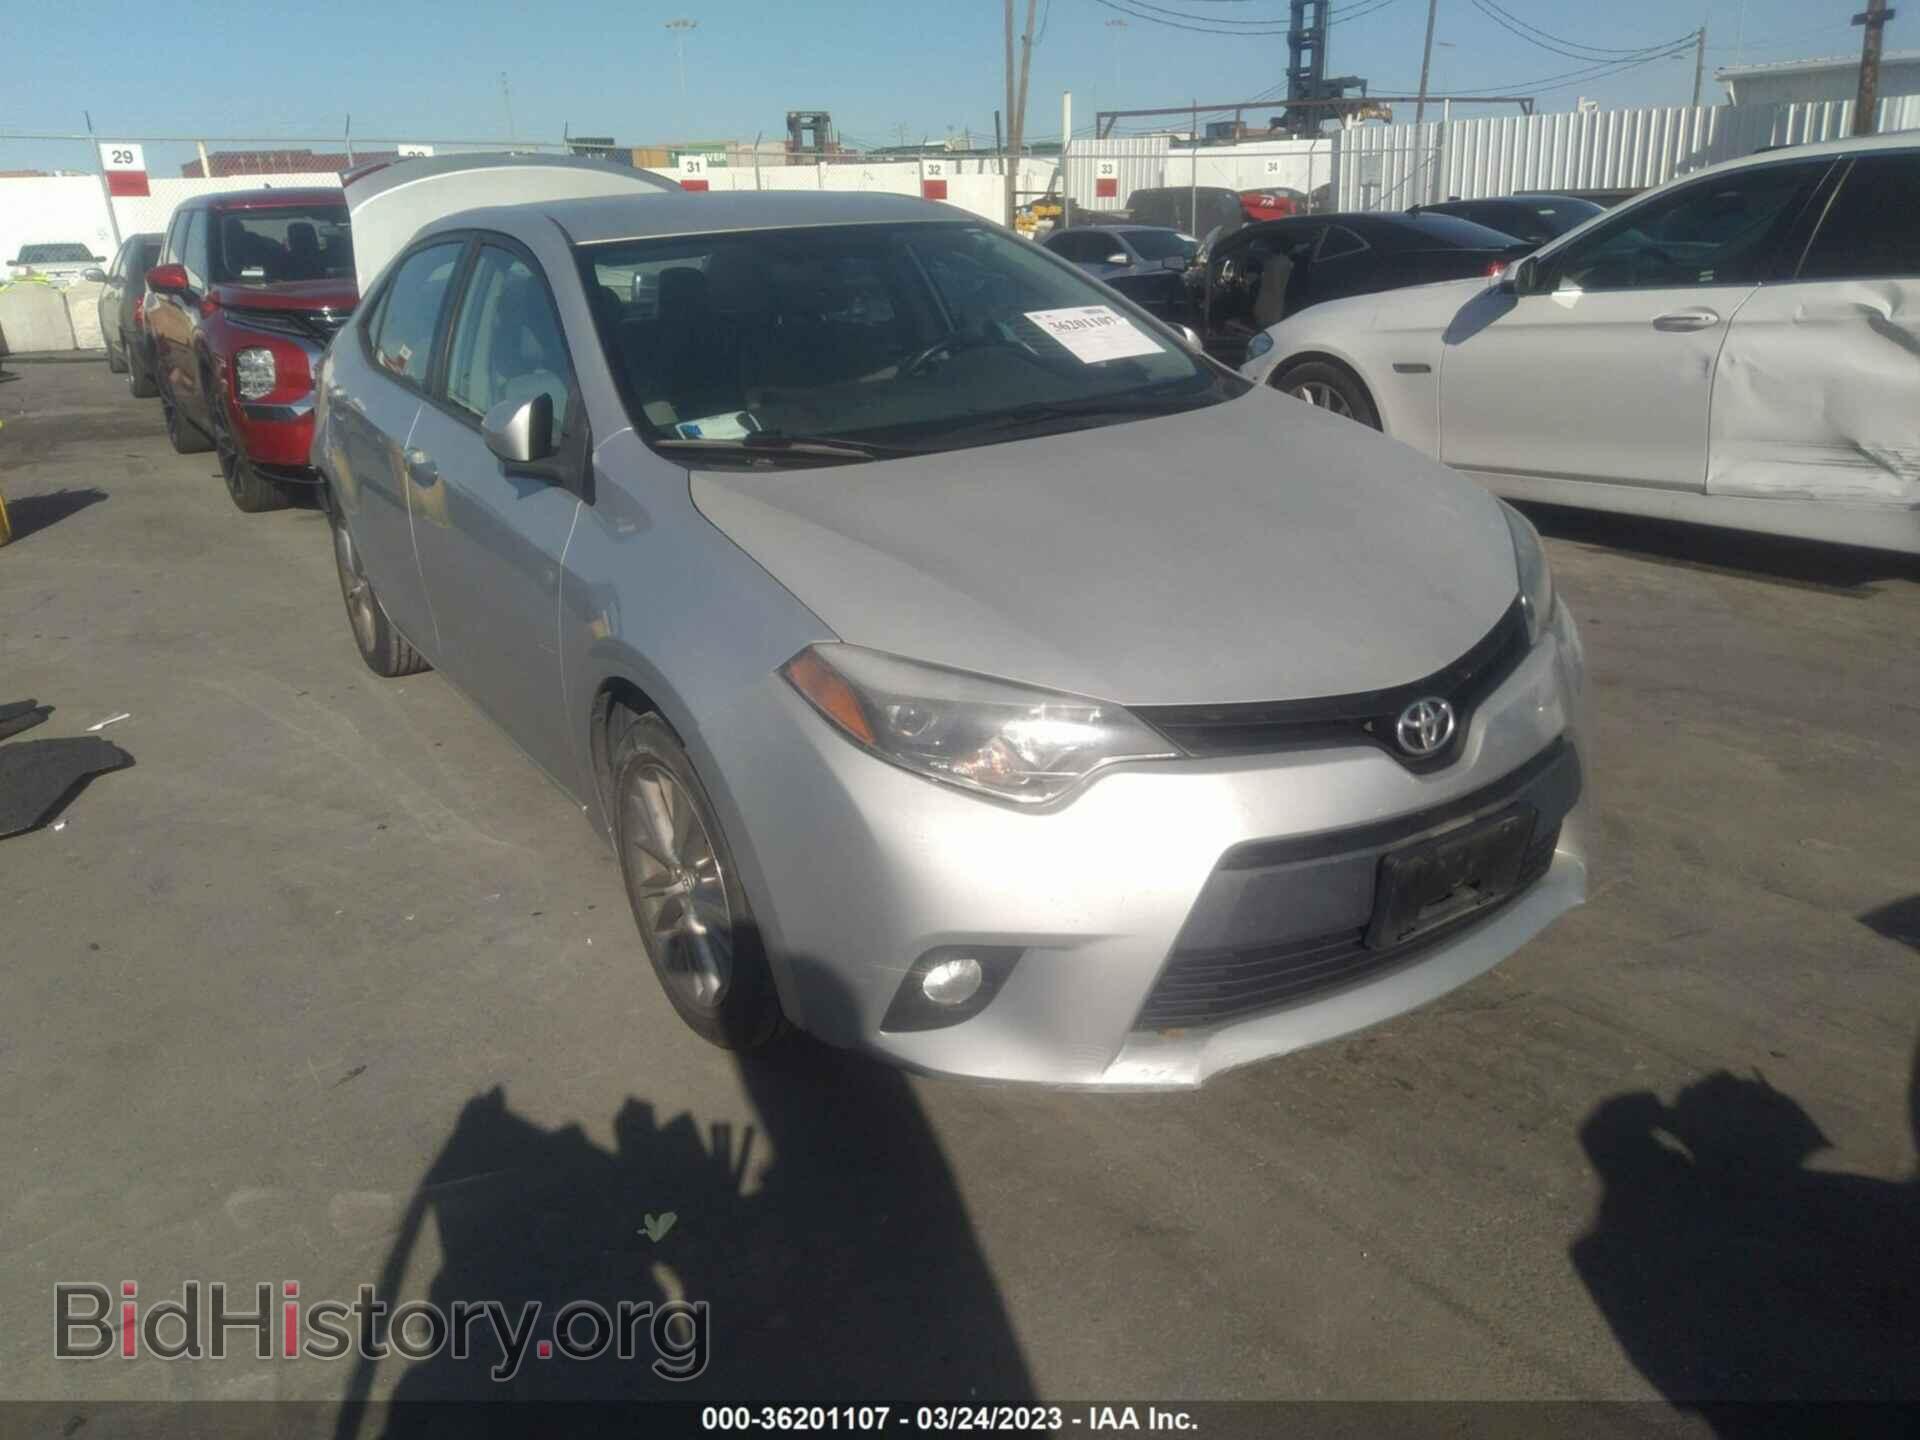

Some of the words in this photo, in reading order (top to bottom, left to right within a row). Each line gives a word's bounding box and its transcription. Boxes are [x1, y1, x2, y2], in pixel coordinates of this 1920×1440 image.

[112, 150, 133, 164] 29
[687, 161, 700, 173] 31
[928, 164, 941, 175] 32
[1101, 163, 1113, 175] 33
[1267, 162, 1278, 172] 34
